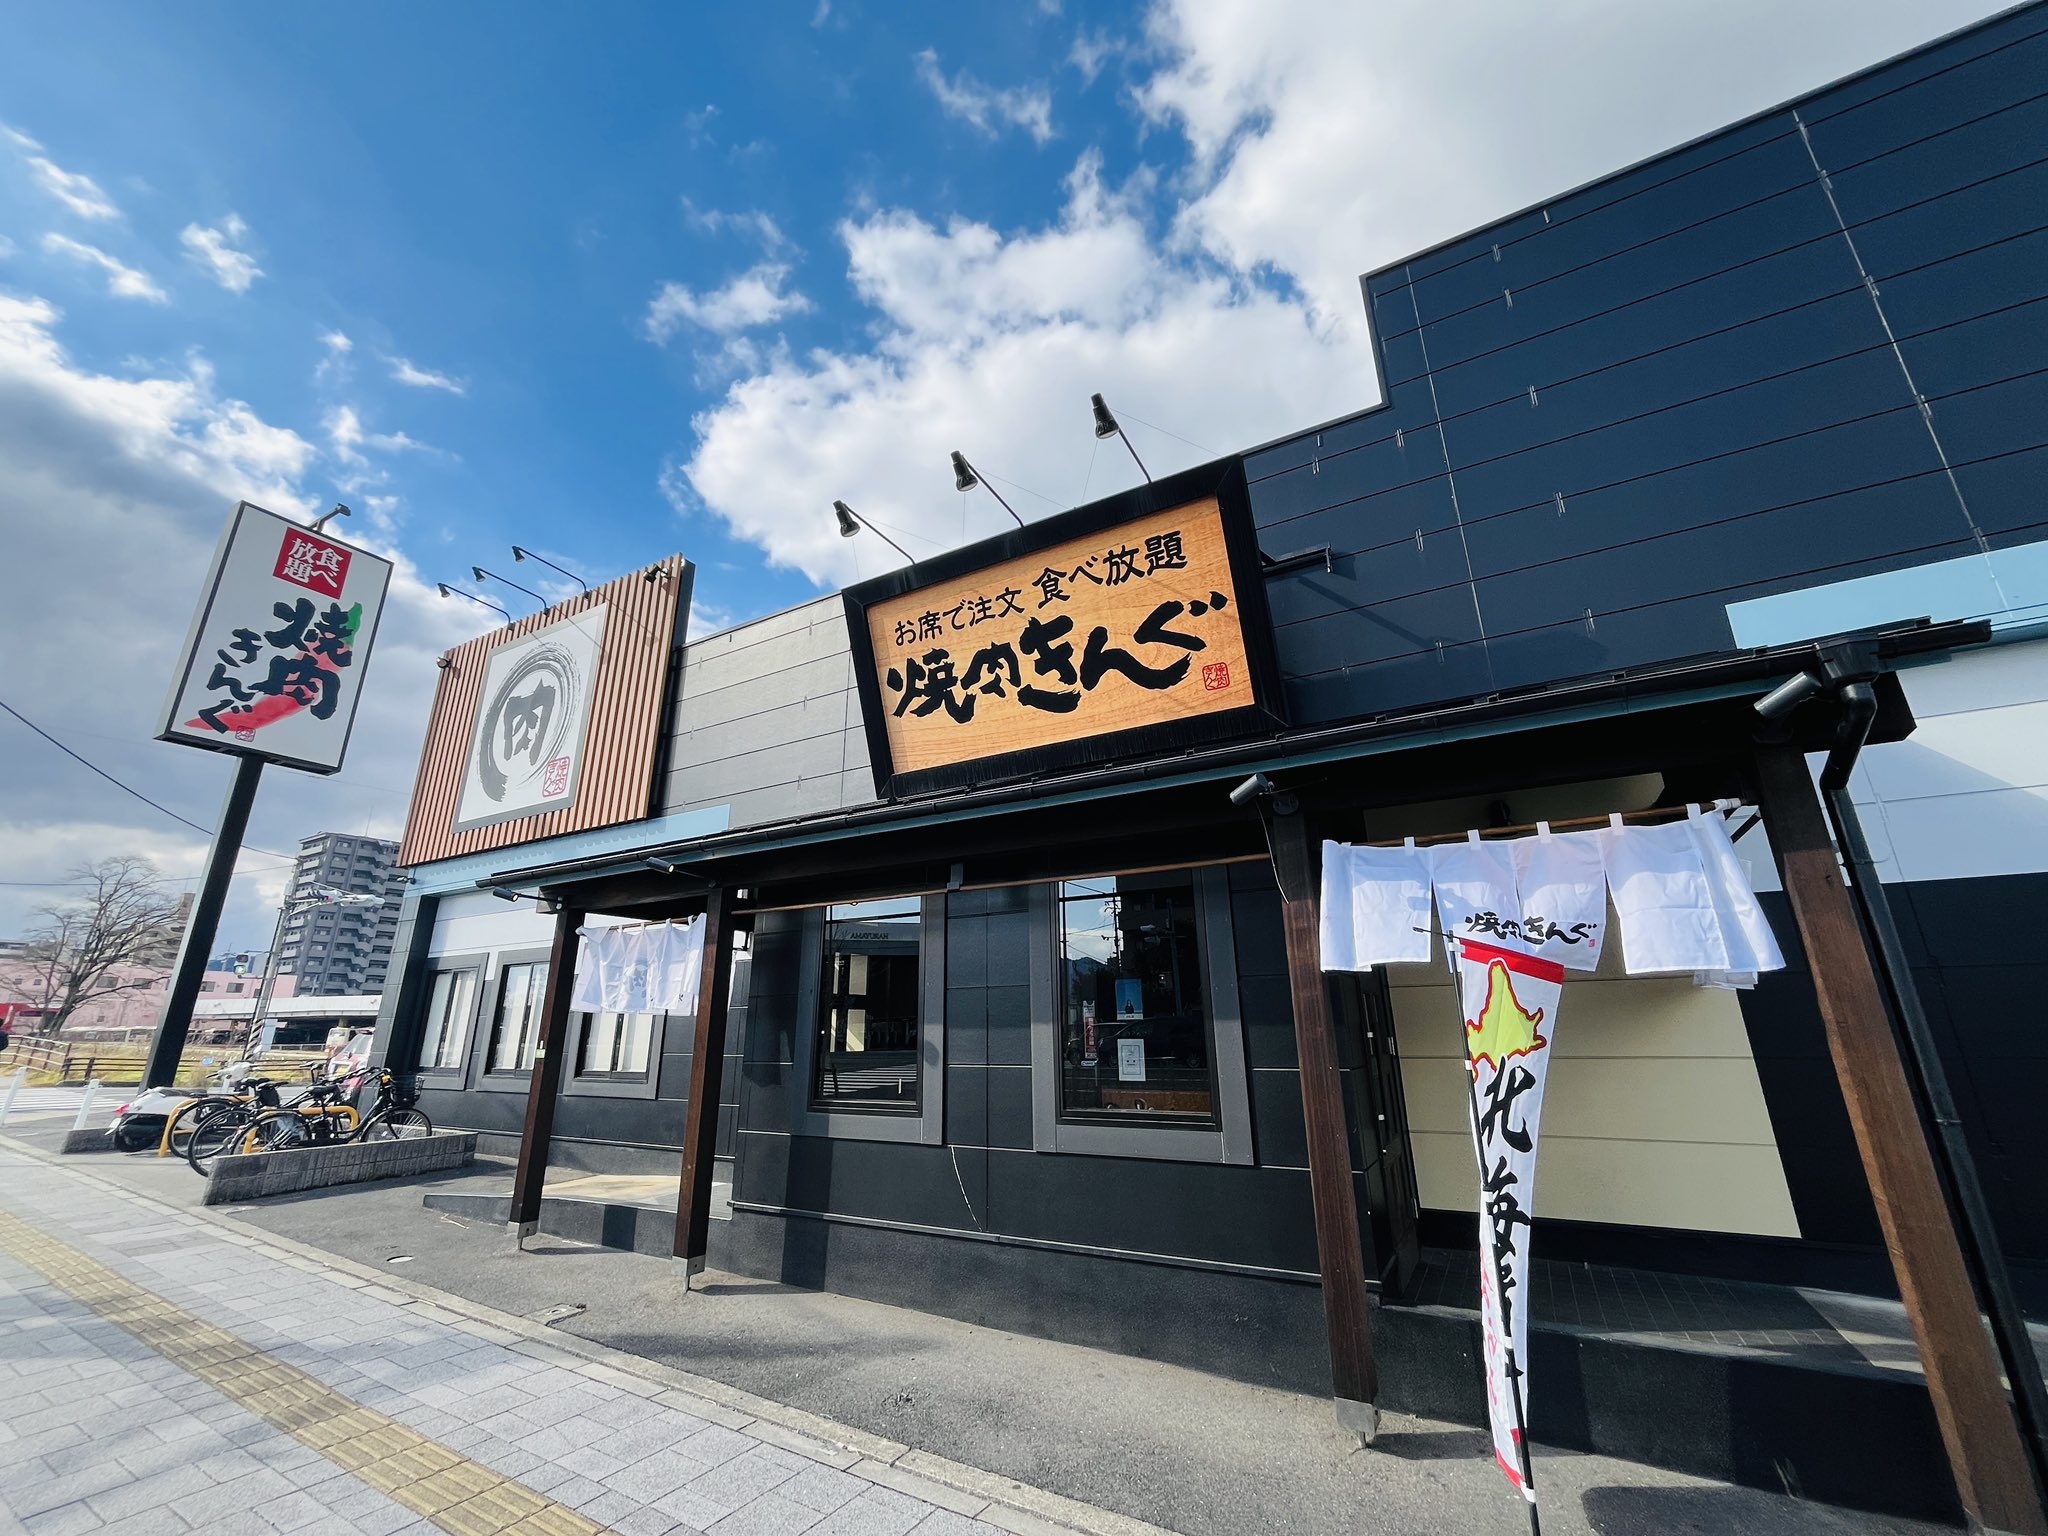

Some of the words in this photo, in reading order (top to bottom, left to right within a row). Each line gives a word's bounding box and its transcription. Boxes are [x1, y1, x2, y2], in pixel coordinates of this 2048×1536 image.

[281, 538, 315, 584] 放題
[312, 547, 344, 588] 食べ
[895, 588, 1026, 646] お席で注文
[1032, 530, 1188, 608] 食べ放題
[198, 627, 263, 734] きんぐ
[250, 597, 354, 720] 焼肉
[886, 591, 1228, 724] 焼肉きんぐ
[503, 678, 556, 766] 肉
[1464, 911, 1597, 945] 焼肉きんぐ
